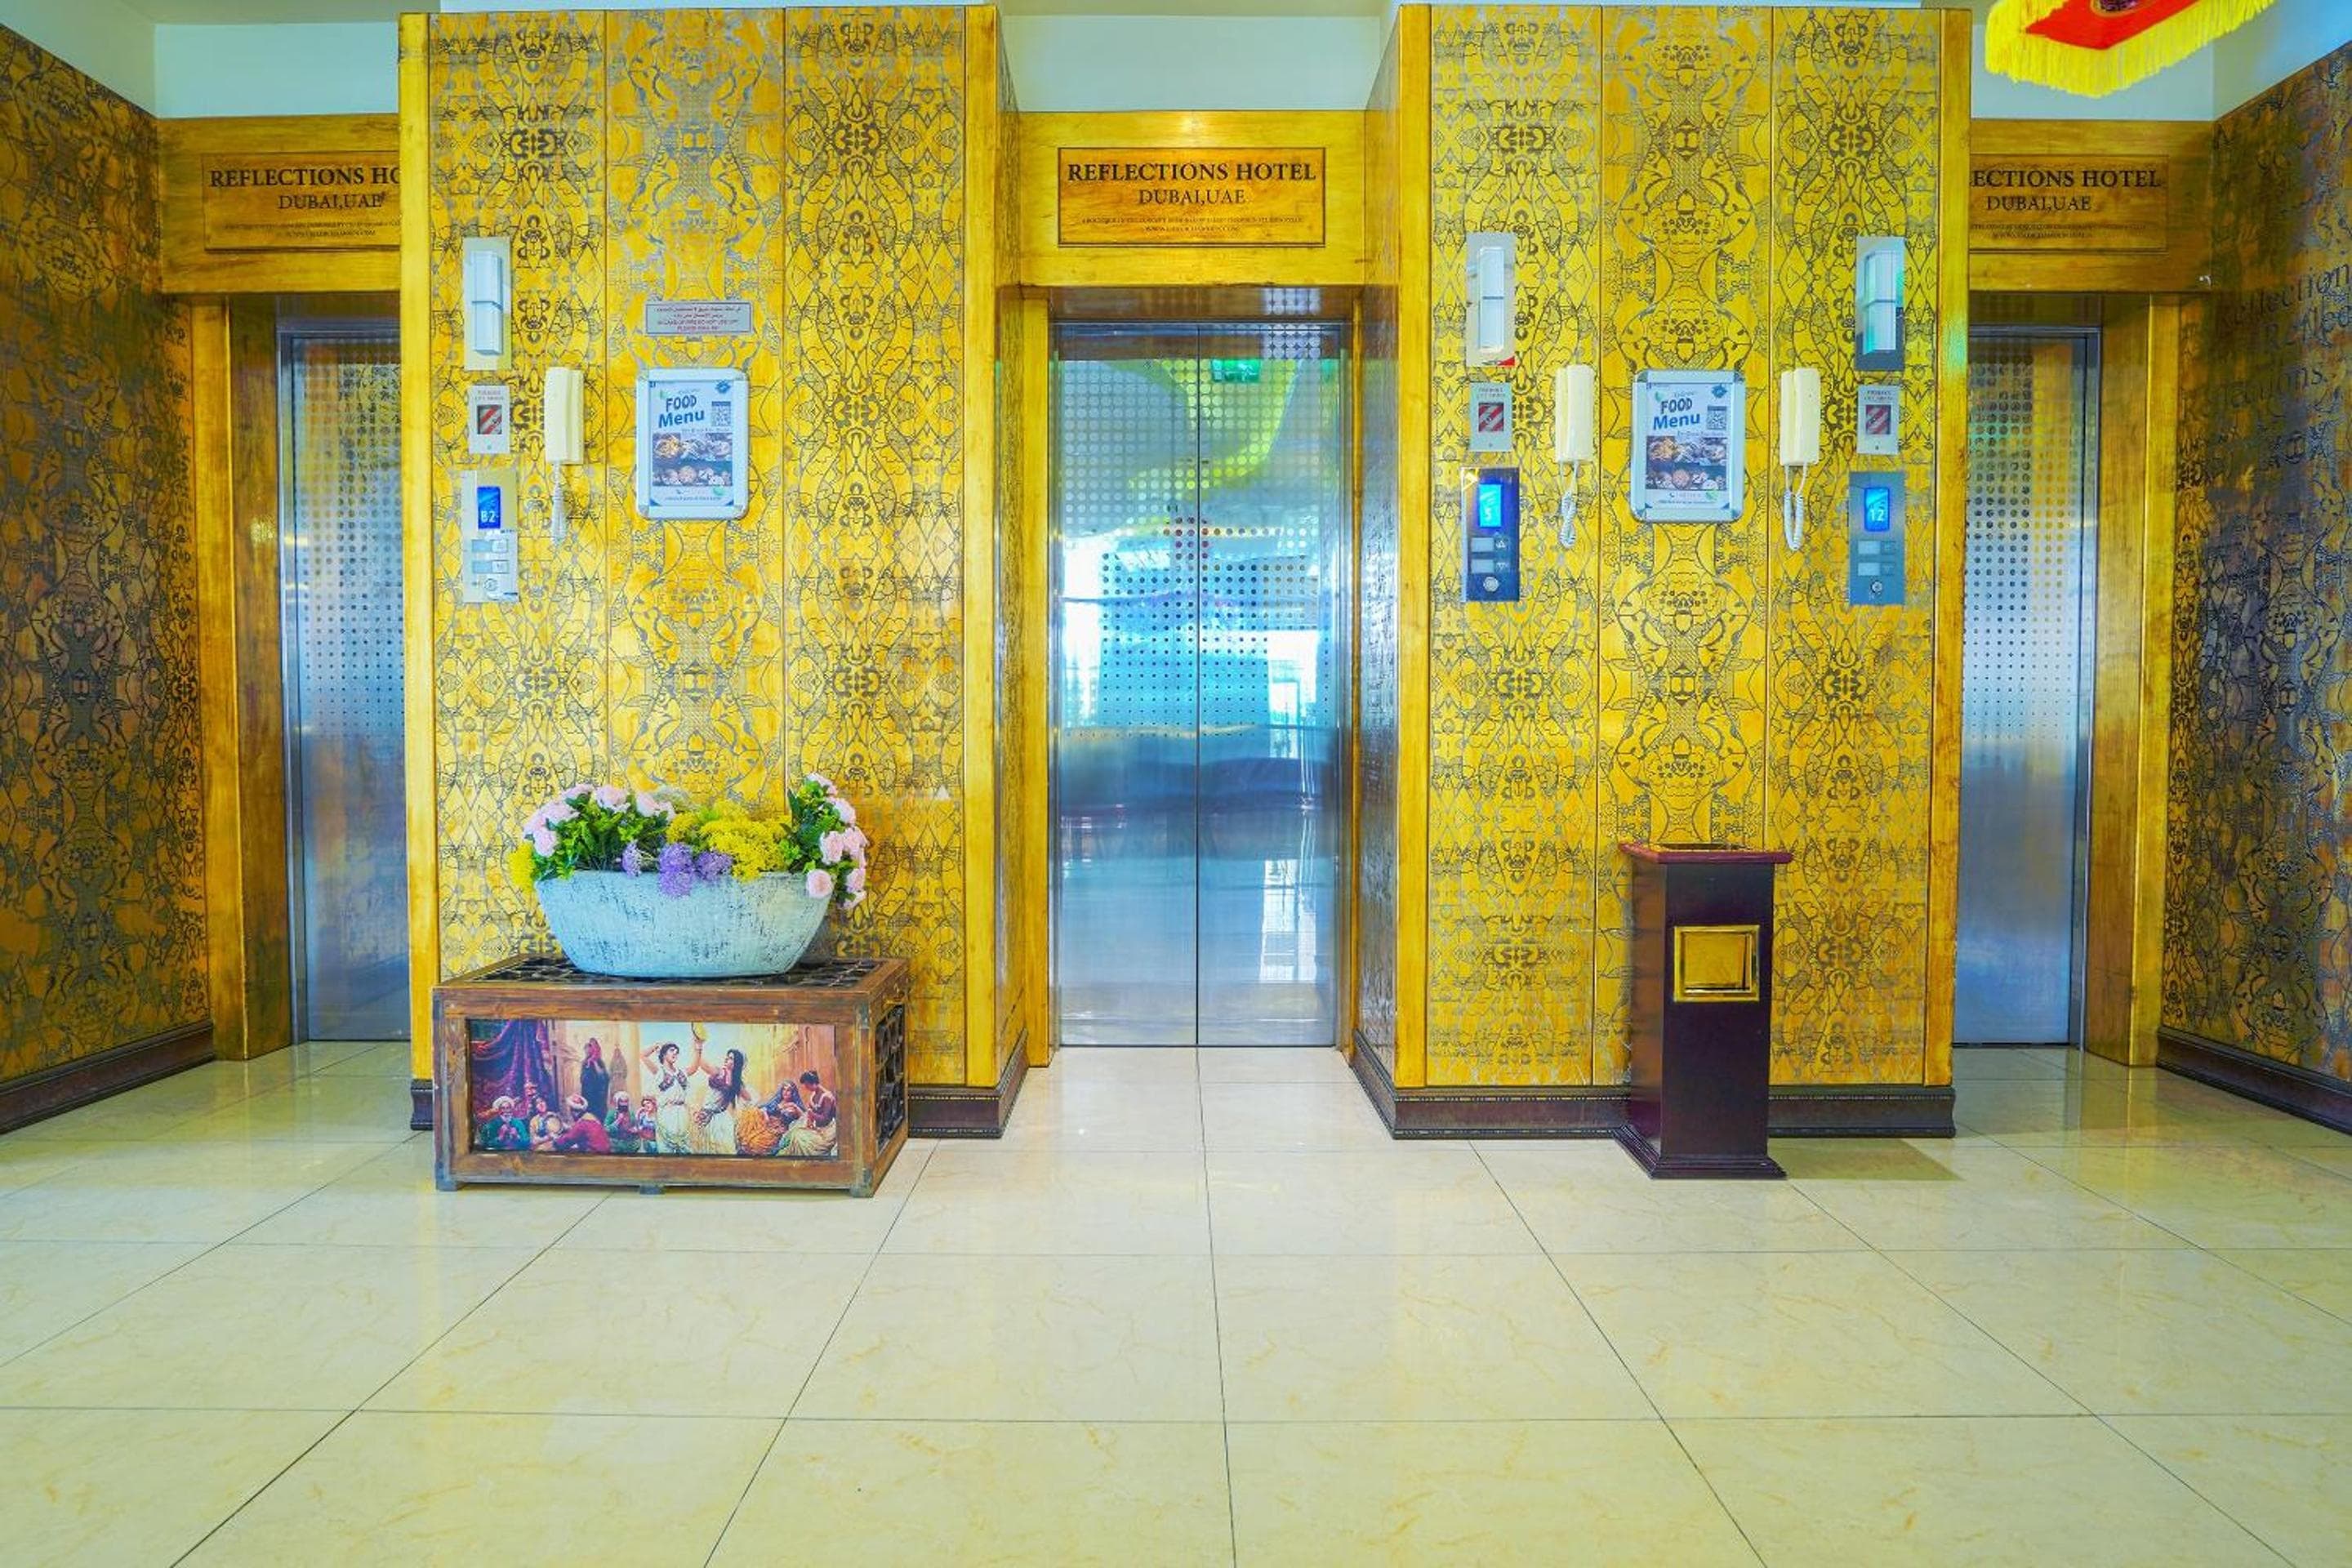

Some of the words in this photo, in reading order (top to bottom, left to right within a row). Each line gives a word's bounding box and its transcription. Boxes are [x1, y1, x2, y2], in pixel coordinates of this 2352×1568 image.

[210, 167, 365, 187] REFLECTIONS
[1067, 163, 1228, 181] REFLECTIONS
[1236, 163, 1316, 181] HOTEL
[1969, 169, 2074, 188] ECTIONS
[2082, 169, 2162, 188] HOTEL
[666, 394, 697, 412] FOOD
[1660, 398, 1693, 414] FOOD
[658, 410, 705, 429] Menu
[1653, 413, 1700, 430] Menu
[480, 510, 496, 523] B2
[1869, 509, 1885, 522] 12
